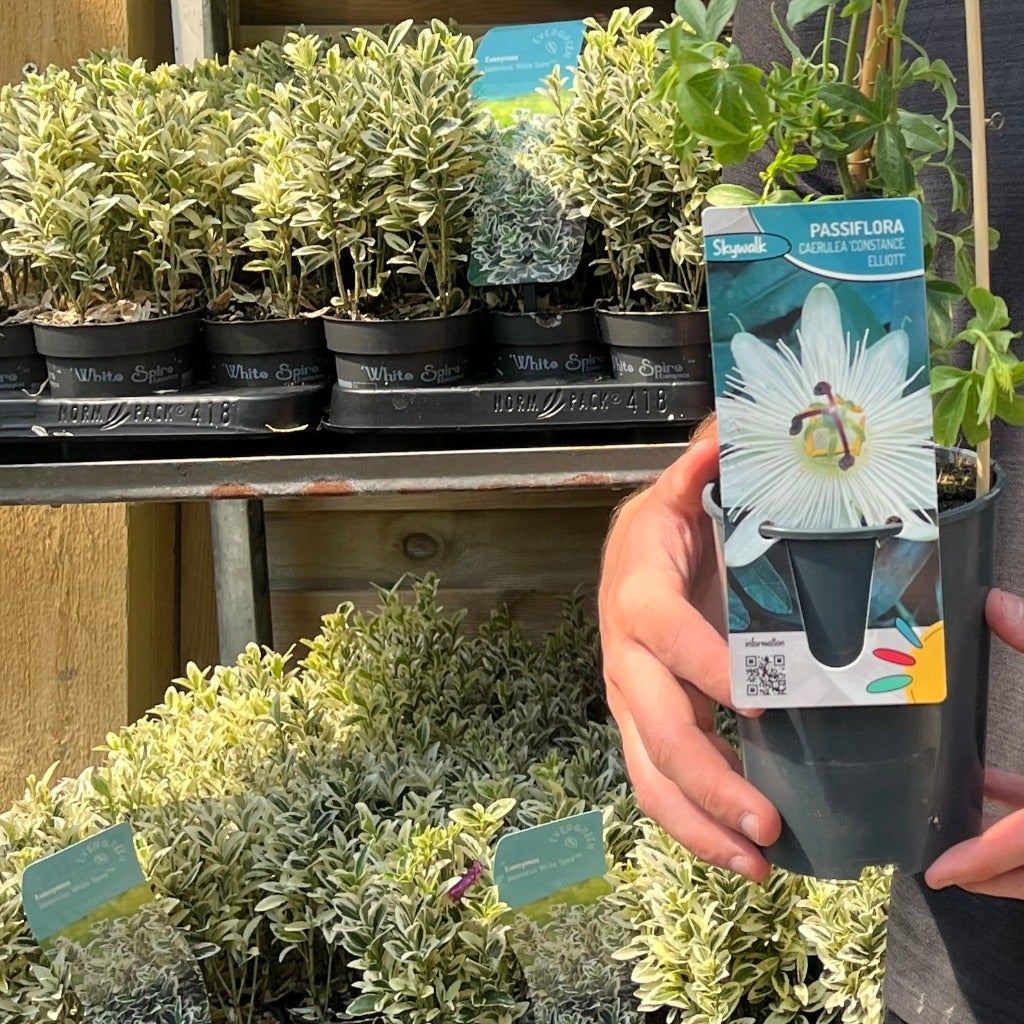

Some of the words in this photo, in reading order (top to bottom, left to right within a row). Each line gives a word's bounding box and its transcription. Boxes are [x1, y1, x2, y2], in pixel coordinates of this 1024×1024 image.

[810, 219, 905, 238] PASSIFLORA
[713, 238, 767, 258] Skywalk
[799, 242, 848, 255] CAERULEA
[626, 388, 668, 415] 418
[191, 401, 231, 427] 418
[745, 637, 785, 648] information
